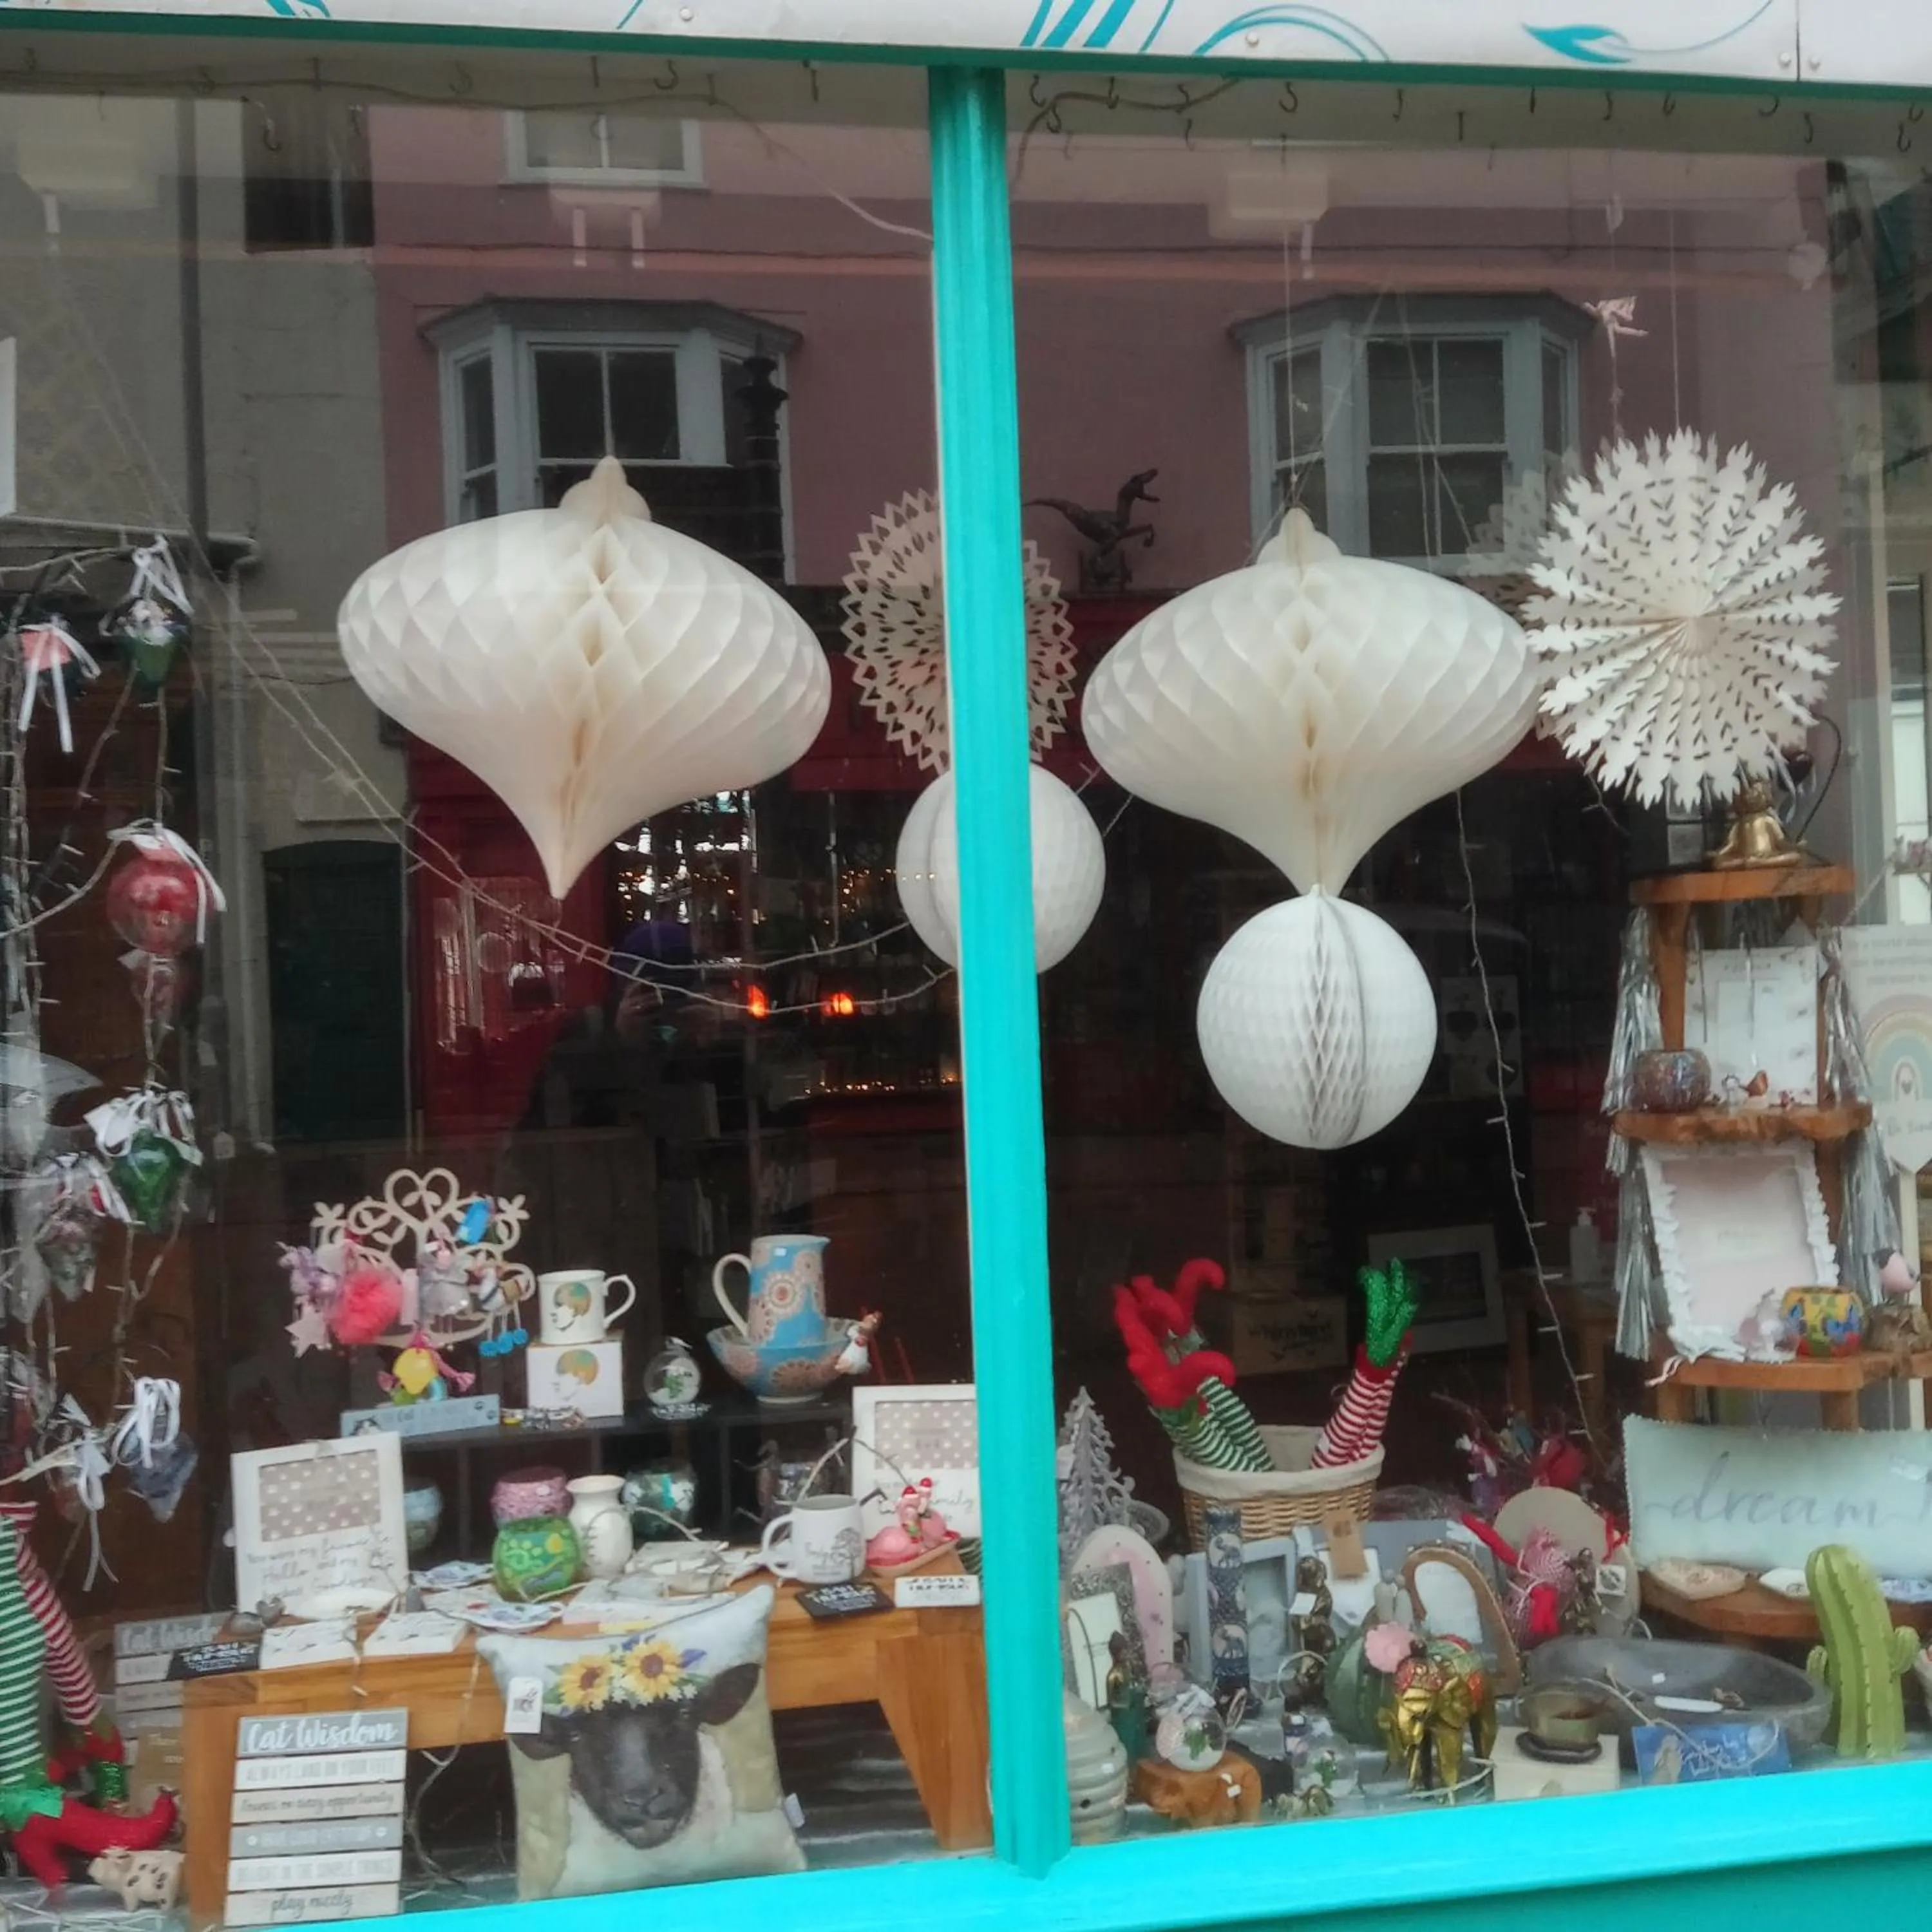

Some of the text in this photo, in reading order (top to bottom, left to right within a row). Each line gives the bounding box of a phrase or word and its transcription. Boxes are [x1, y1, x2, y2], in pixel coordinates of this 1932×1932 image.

[1646, 1451, 1893, 1528] dream
[247, 1712, 400, 1753] Cat Wisdom
[270, 1892, 307, 1920] play
